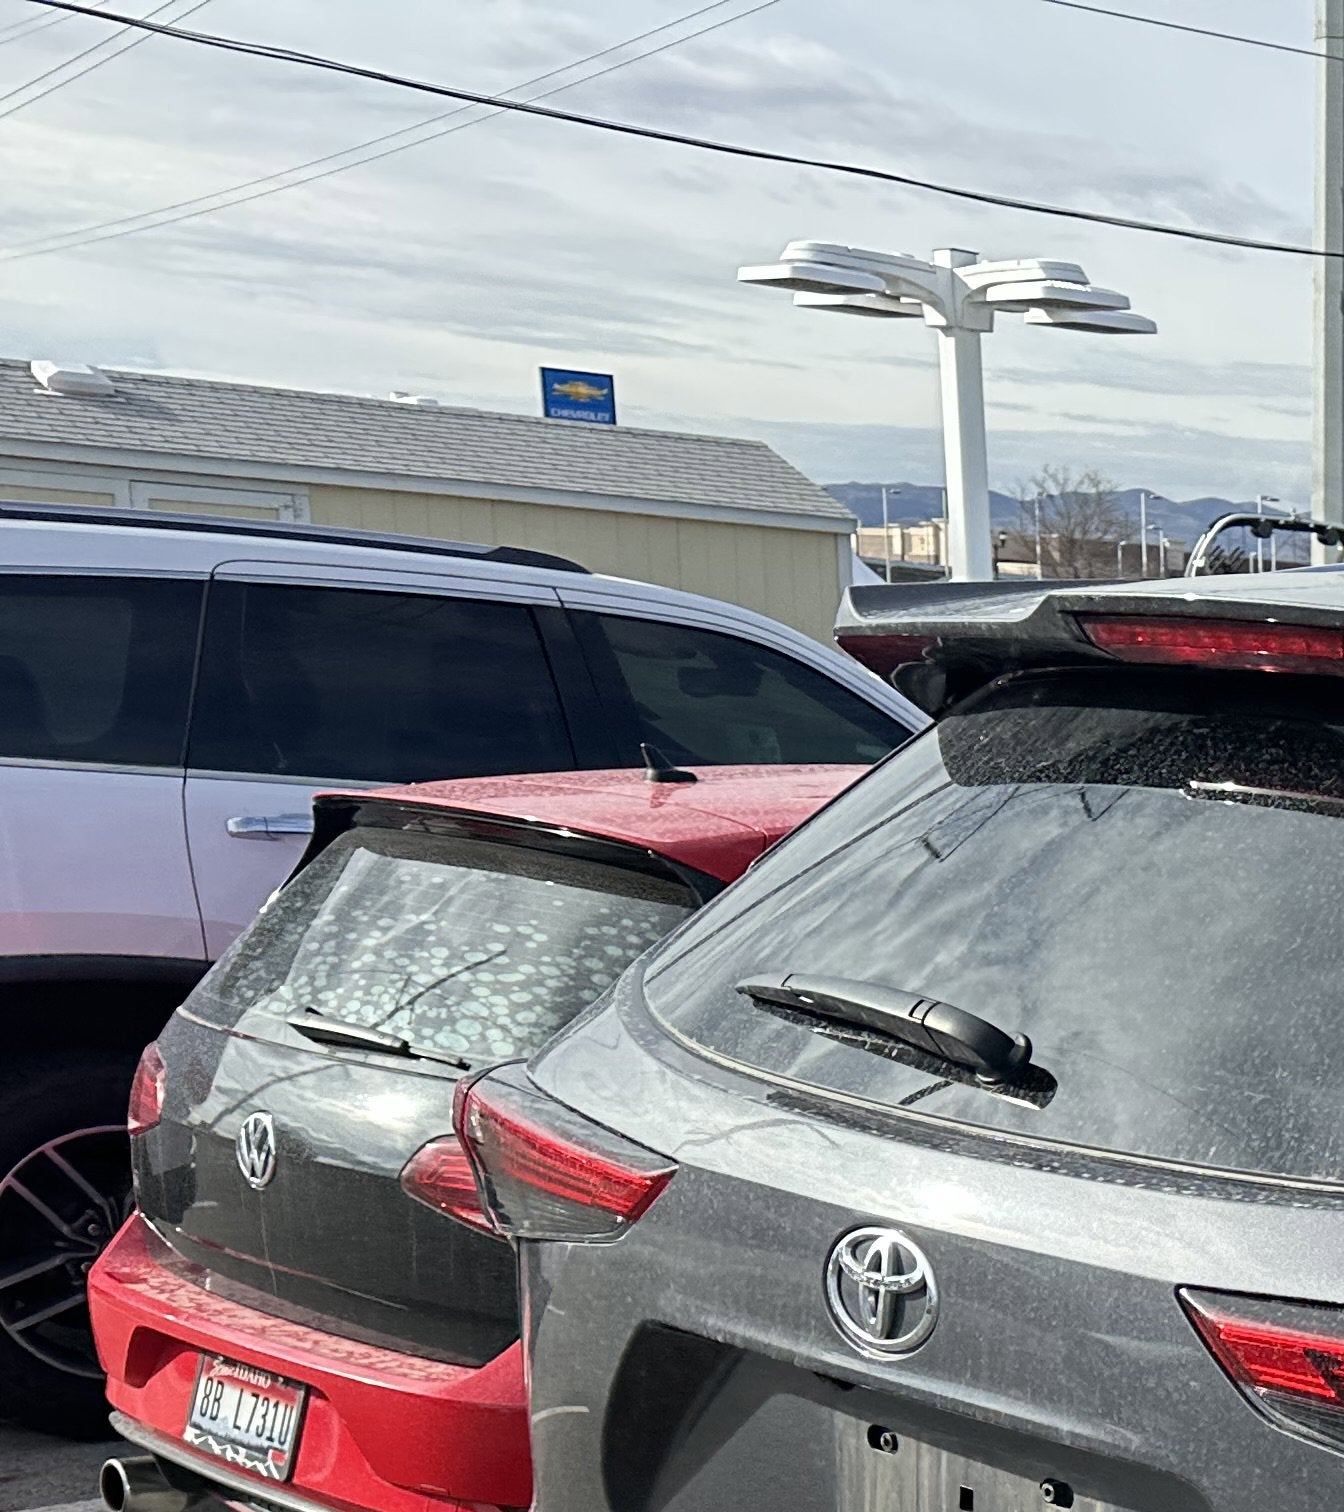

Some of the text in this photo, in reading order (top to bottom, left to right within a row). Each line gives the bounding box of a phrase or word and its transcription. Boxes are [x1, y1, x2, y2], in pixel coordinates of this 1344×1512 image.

[550, 408, 610, 421] CHEVROLET
[234, 1364, 272, 1389] IDAHO
[200, 1376, 295, 1446] 8B L731U
